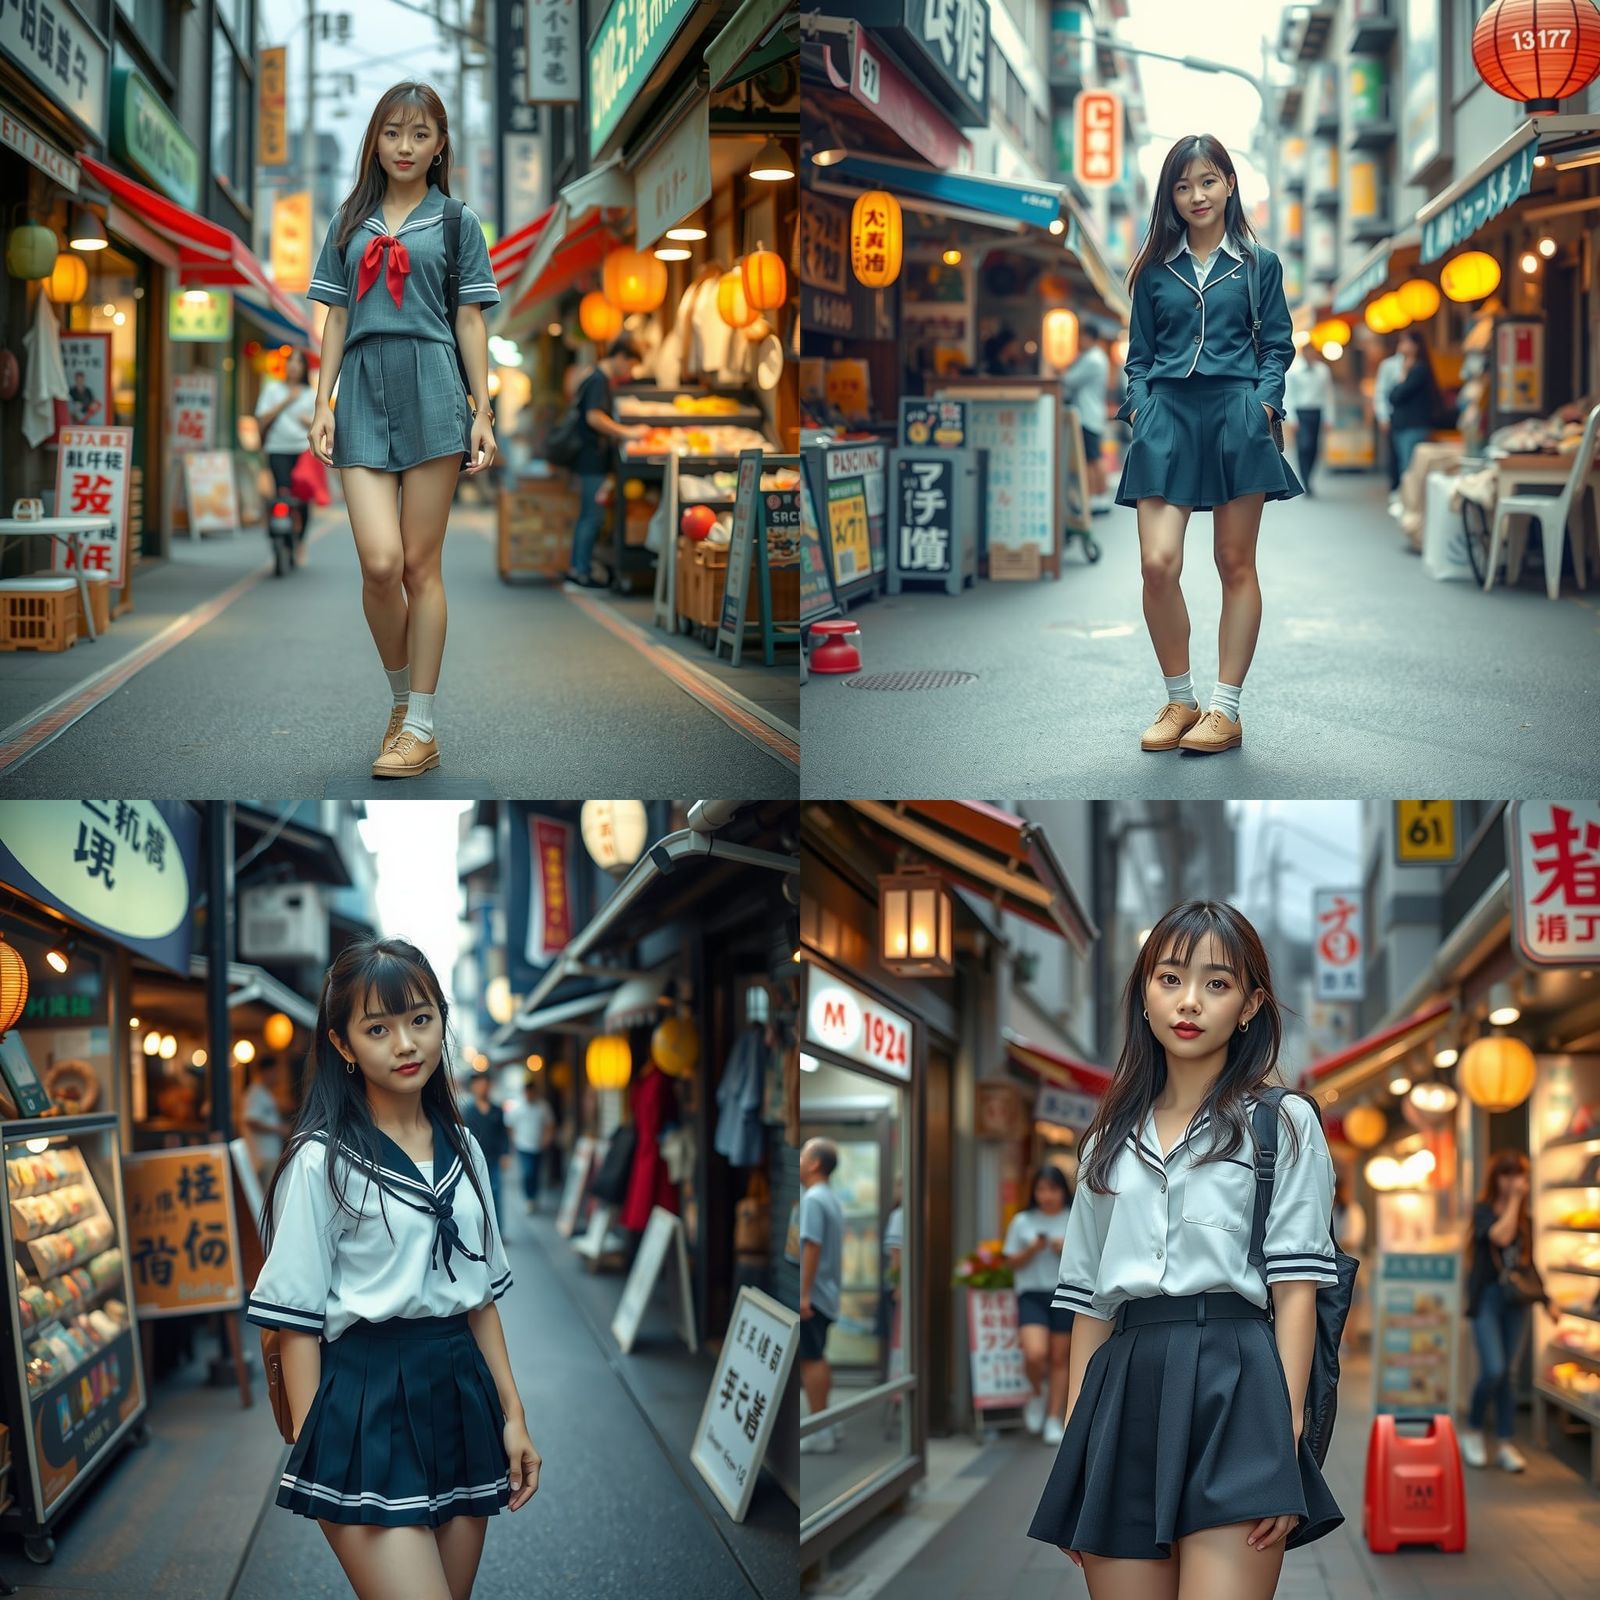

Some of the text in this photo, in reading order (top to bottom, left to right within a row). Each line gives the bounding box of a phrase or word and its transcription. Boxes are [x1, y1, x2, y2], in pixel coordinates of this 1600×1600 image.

[1511, 28, 1572, 51] 13177
[1407, 817, 1443, 846] 61
[823, 1001, 906, 1067] M 1924
